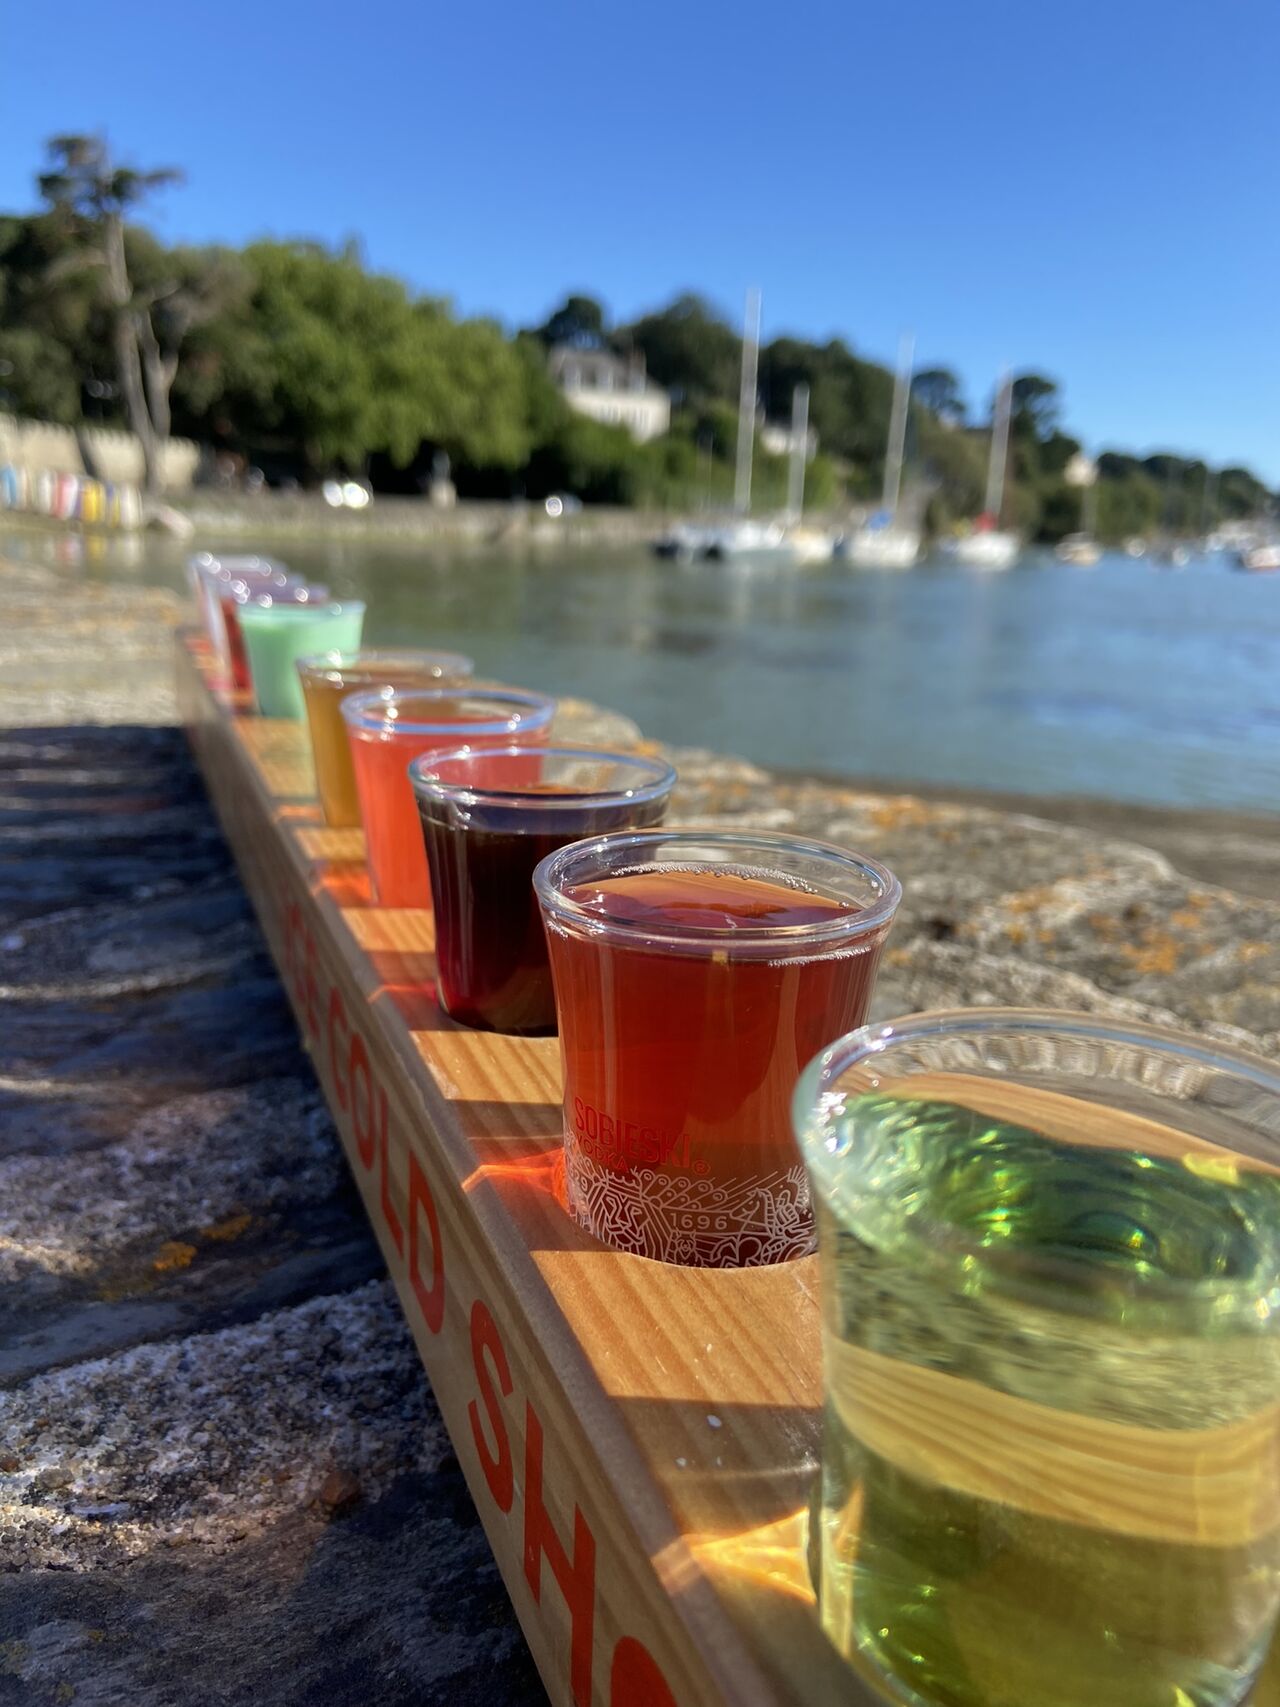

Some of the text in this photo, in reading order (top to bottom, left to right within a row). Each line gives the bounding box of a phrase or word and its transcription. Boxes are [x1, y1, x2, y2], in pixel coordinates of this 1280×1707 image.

[574, 1096, 691, 1168] SOBIESKI
[670, 1211, 728, 1231] 1696
[328, 986, 445, 1335] COLD
[467, 1299, 677, 1707] SH
